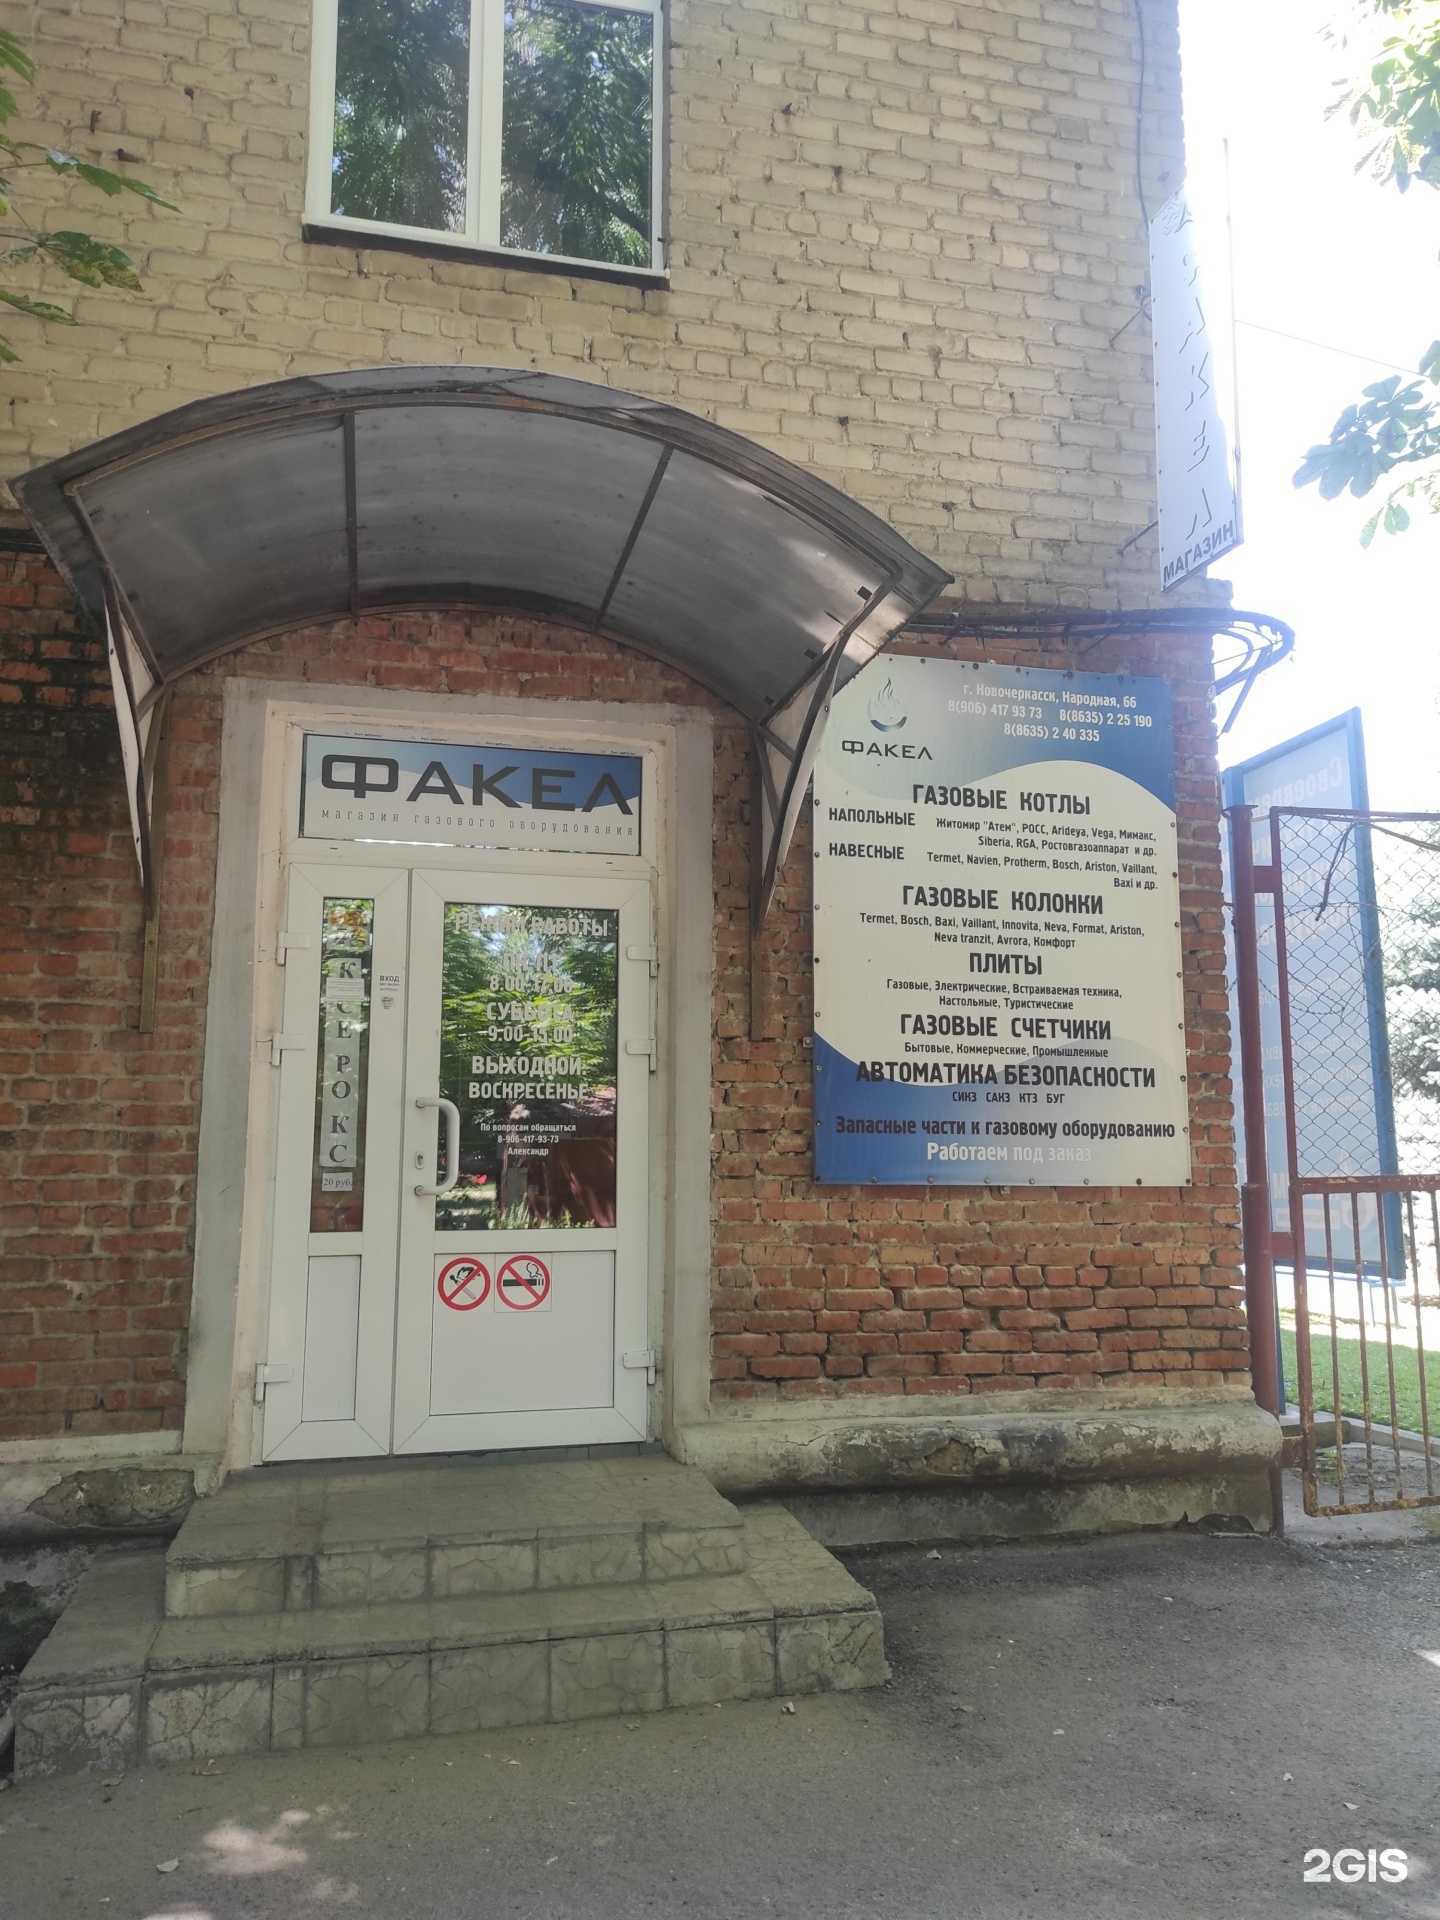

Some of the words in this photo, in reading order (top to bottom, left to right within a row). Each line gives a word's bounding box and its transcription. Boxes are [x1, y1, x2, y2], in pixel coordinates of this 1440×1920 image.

[1163, 519, 1234, 584] МАГАЗИН
[976, 684, 1059, 704] Новочеркасск,
[1062, 691, 1120, 708] Народная,
[948, 700, 986, 716] 8(906)
[990, 704, 1008, 715] 417
[1012, 705, 1026, 718] 93
[1029, 706, 1042, 719] 73
[1059, 709, 1104, 725] 8(8635)
[1107, 713, 1114, 725] 2
[1117, 714, 1131, 726] 25
[1134, 715, 1153, 728] 190
[1004, 723, 1049, 740] 8(8635)
[1052, 727, 1060, 739] 2
[1062, 727, 1076, 740] 40
[1079, 729, 1100, 742] 335
[841, 740, 933, 761] ФАКЕЛ
[321, 754, 634, 816] ФАКЕЛ
[912, 784, 1008, 809] ГАЗОВЫЕ
[1020, 791, 1091, 815] КОТЛЫ
[321, 808, 401, 822] магазин
[413, 814, 495, 829] газового
[509, 819, 634, 837] оборудования
[828, 807, 916, 826] НАПОЛЬНЫЕ
[936, 818, 981, 832] Житомир
[1022, 823, 1049, 836] РОСС,
[1051, 825, 1089, 839] Arideya,
[1091, 828, 1117, 840] Vega,
[1119, 830, 1157, 842] Мимакс,
[828, 842, 905, 860] НАВЕСНЫЕ
[978, 836, 1014, 849] Siberia,
[1016, 838, 1039, 850] RGA,
[1041, 840, 1129, 855] Ростовгазоаппарат
[1134, 846, 1140, 855] и
[1142, 846, 1157, 857] др.
[927, 852, 964, 865] Termet,
[967, 854, 1001, 867] Navien,
[1003, 856, 1050, 869] Protherm,
[1052, 859, 1082, 872] Bosch,
[1085, 861, 1120, 873] Ariston,
[1122, 863, 1158, 875] Vaillant,
[1113, 877, 1133, 888] Baxi
[1136, 880, 1142, 889] и
[1144, 880, 1158, 891] др.
[902, 885, 999, 910] ГАЗОВЫЕ
[1011, 891, 1104, 915] КОЛОНКИ
[859, 912, 898, 925] Termet,
[900, 914, 933, 927] Bosch,
[935, 916, 959, 928] Baxi,
[961, 918, 999, 930] Vaillant,
[1002, 920, 1042, 932] Innovita,
[1044, 922, 1070, 934] Neva,
[1072, 923, 1108, 935] Format,
[1110, 925, 1145, 937] Ariston,
[934, 931, 958, 943] Neva
[960, 933, 994, 946] tranzit,
[997, 935, 1031, 947] Avrora,
[1033, 936, 1076, 949] Комфорт
[969, 952, 1042, 975] ПЛИТЫ
[379, 975, 400, 983] ВХОД
[887, 978, 932, 992] Газовые,
[935, 980, 1010, 994] Электрические,
[1012, 983, 1080, 997] Встраиваемая
[1082, 986, 1122, 998] техника,
[939, 996, 1001, 1008] Настольные,
[1003, 997, 1074, 1011] Туристические
[900, 1014, 998, 1037] ГАЗОВЫЕ
[1011, 1017, 1112, 1040] СЧЕТЧИКИ
[904, 1042, 954, 1054] Бытовые,
[956, 1044, 1029, 1056] Коммерческие,
[1032, 1046, 1109, 1058] Промышленные
[856, 1061, 999, 1085] АВТОМАТИКА
[1004, 1064, 1156, 1088] БЕЗОПАСНОСТИ
[468, 1081, 589, 1099] ВОСКРЕСЕНЬЕ
[1019, 1092, 1038, 1104] КТЗ
[1046, 1093, 1065, 1104] БУГ
[480, 1123, 491, 1132] По
[493, 1124, 529, 1132] вопросам
[530, 1123, 577, 1133] обращаться
[835, 1116, 917, 1135] Запасные
[921, 1119, 966, 1135] части
[971, 1120, 980, 1136] к
[985, 1121, 1058, 1139] газовому
[1062, 1120, 1176, 1140] оборудованию
[507, 1147, 549, 1157] Александр
[927, 1142, 1008, 1161] Работаем
[1013, 1147, 1043, 1164] под
[1048, 1147, 1092, 1162] заказ
